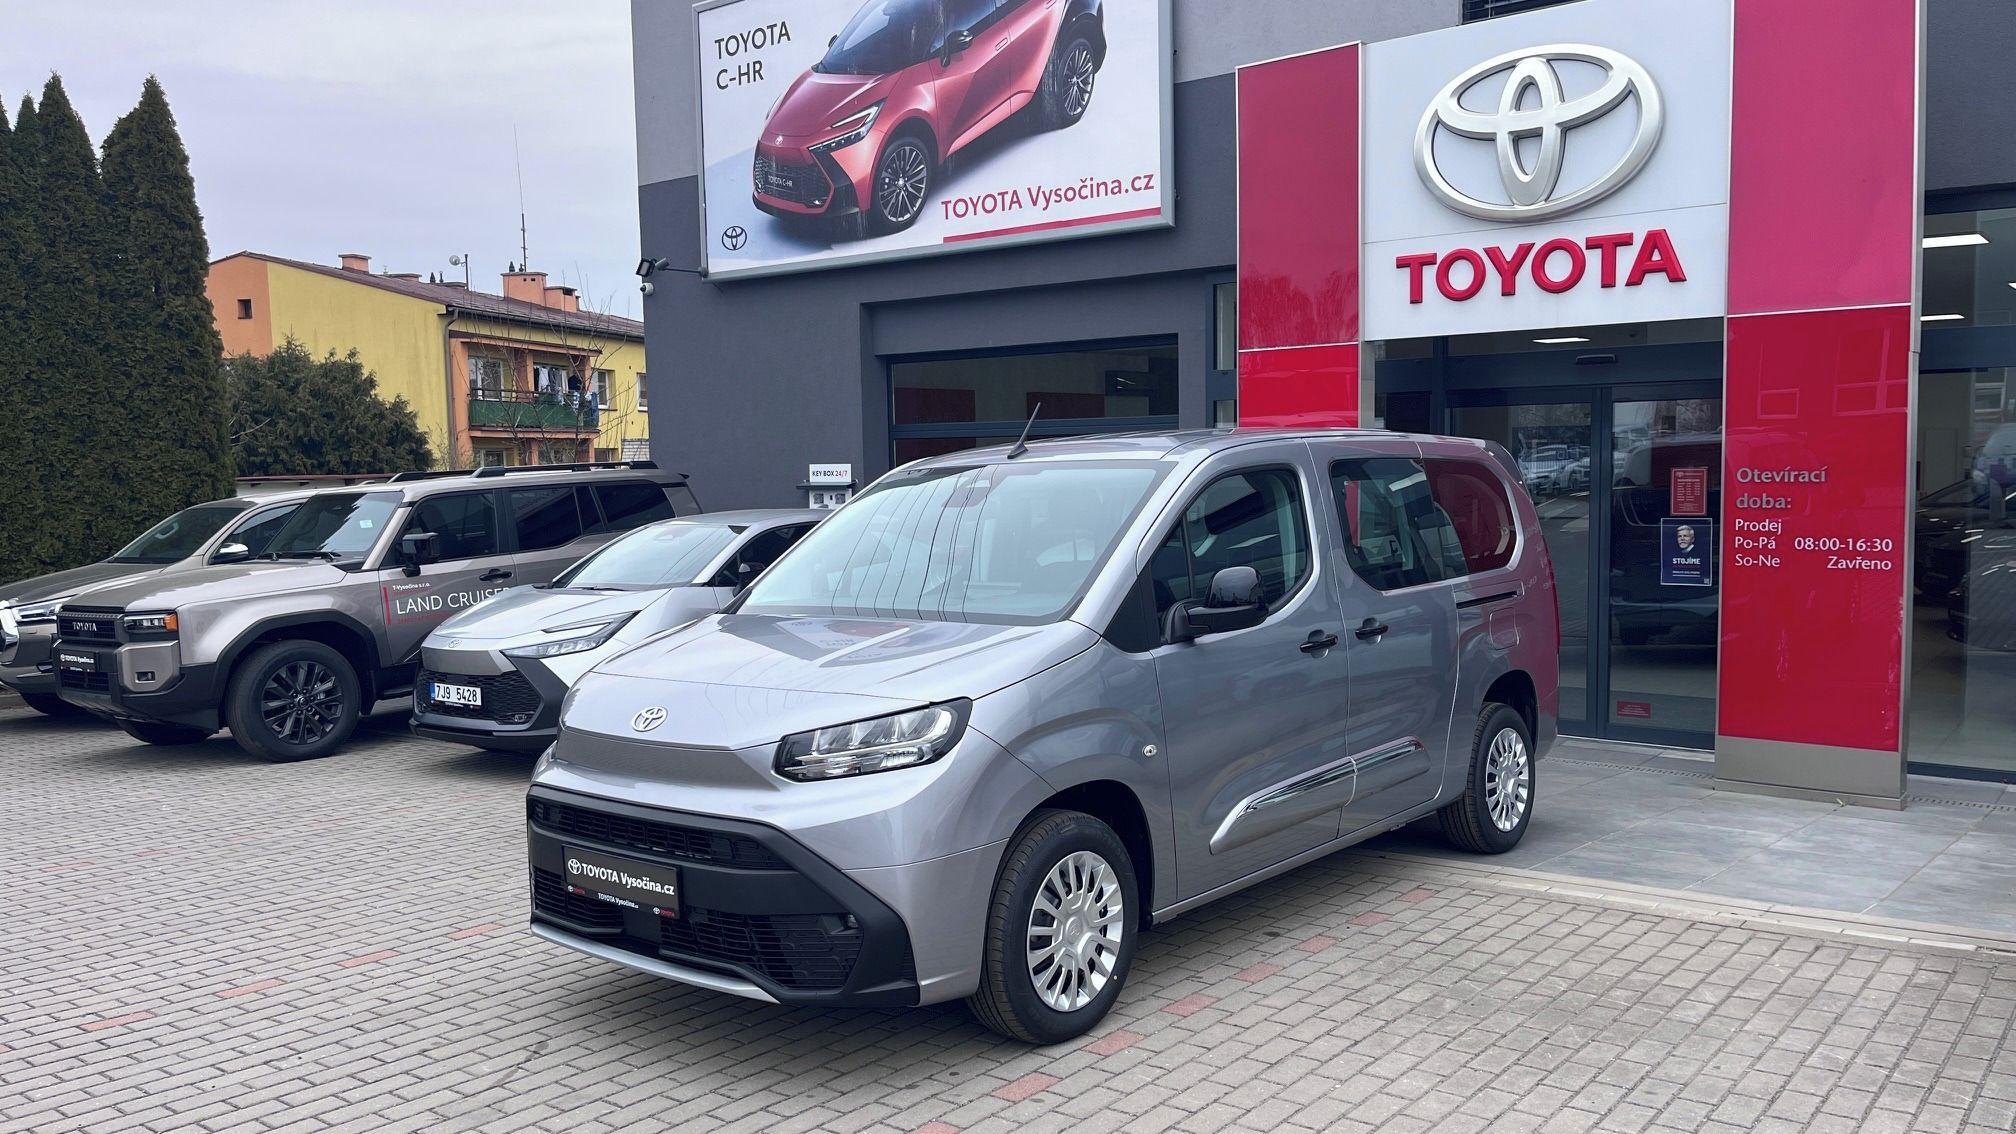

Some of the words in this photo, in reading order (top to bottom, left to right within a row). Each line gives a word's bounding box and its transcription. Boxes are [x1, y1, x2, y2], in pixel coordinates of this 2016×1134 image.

[714, 21, 791, 60] TOYOTA
[716, 60, 764, 90] C-HR
[941, 189, 1023, 220] TOYOTA
[1027, 174, 1155, 211] Vysočina.cz
[1395, 228, 1687, 304] TOYOTA
[835, 470, 848, 478] 24/7
[1736, 466, 1828, 483] Otevírací
[1736, 493, 1792, 509] doba:
[1735, 518, 1782, 535] Prodej
[1735, 536, 1776, 550] Po-Pá
[1794, 537, 1893, 552] 08:00-16:30
[1735, 554, 1781, 567] So-Ne
[1826, 556, 1893, 570] Zavřeno
[396, 595, 443, 615] LAND
[72, 621, 97, 631] TOYOTA
[436, 685, 451, 700] 7J9
[456, 687, 478, 703] 5428
[581, 863, 619, 883] TOYOTA
[620, 872, 675, 895] Vysočina.cz
[597, 892, 616, 903] TOYOTA
